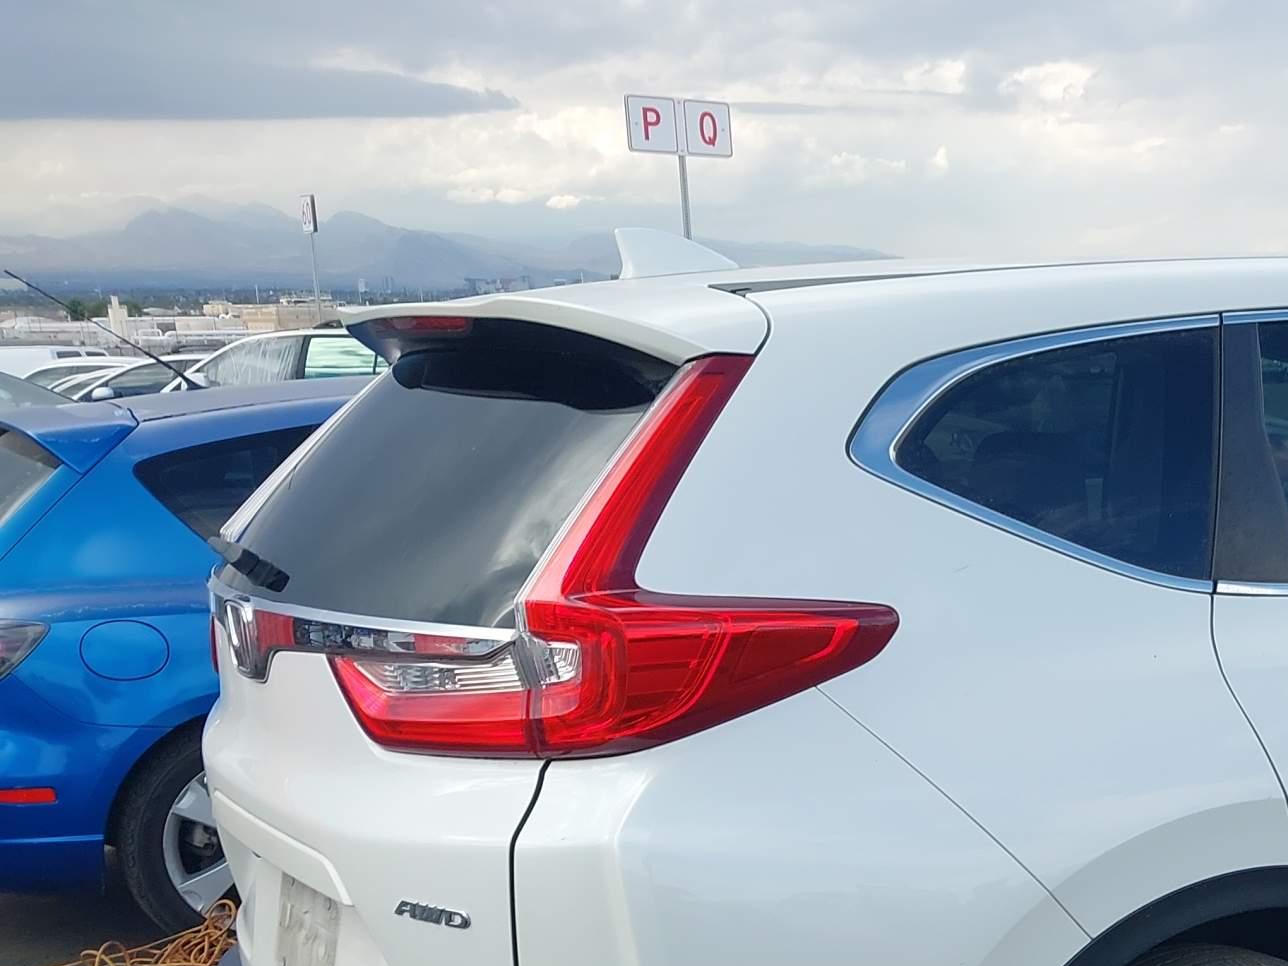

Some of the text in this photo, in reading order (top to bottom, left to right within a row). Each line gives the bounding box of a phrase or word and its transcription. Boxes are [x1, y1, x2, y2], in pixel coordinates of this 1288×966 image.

[642, 106, 661, 141] P
[699, 111, 718, 147] Q
[394, 899, 471, 930] AWD
